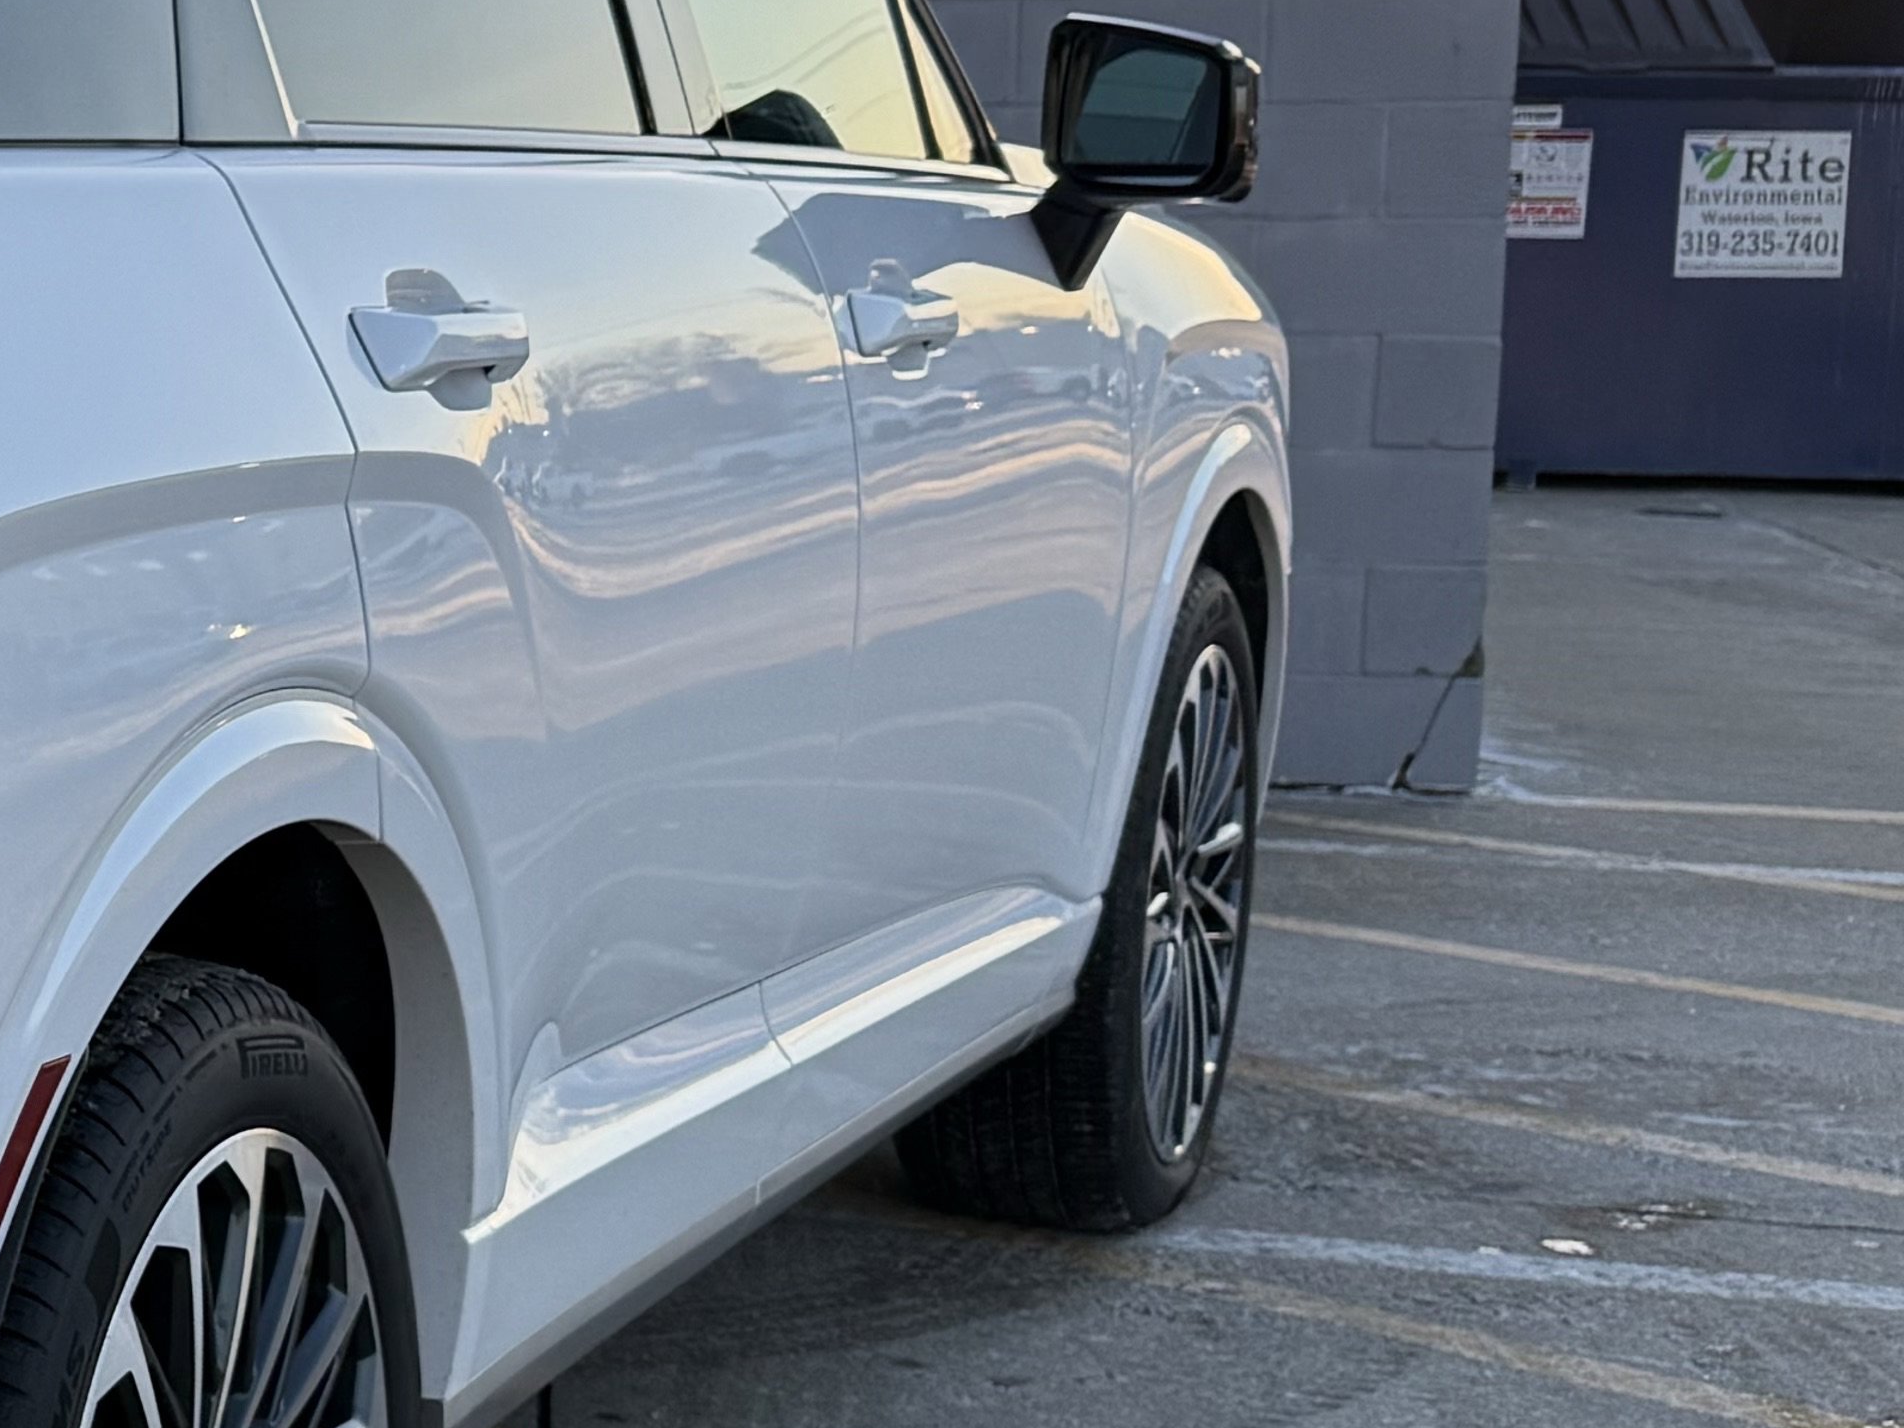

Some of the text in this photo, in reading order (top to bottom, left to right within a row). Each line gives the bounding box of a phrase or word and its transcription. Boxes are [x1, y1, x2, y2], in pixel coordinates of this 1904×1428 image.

[1740, 146, 1845, 183] Rite
[1683, 184, 1843, 206] Environmental
[1680, 229, 1839, 257] 319-235-7401
[235, 1034, 309, 1080] PIRELLI
